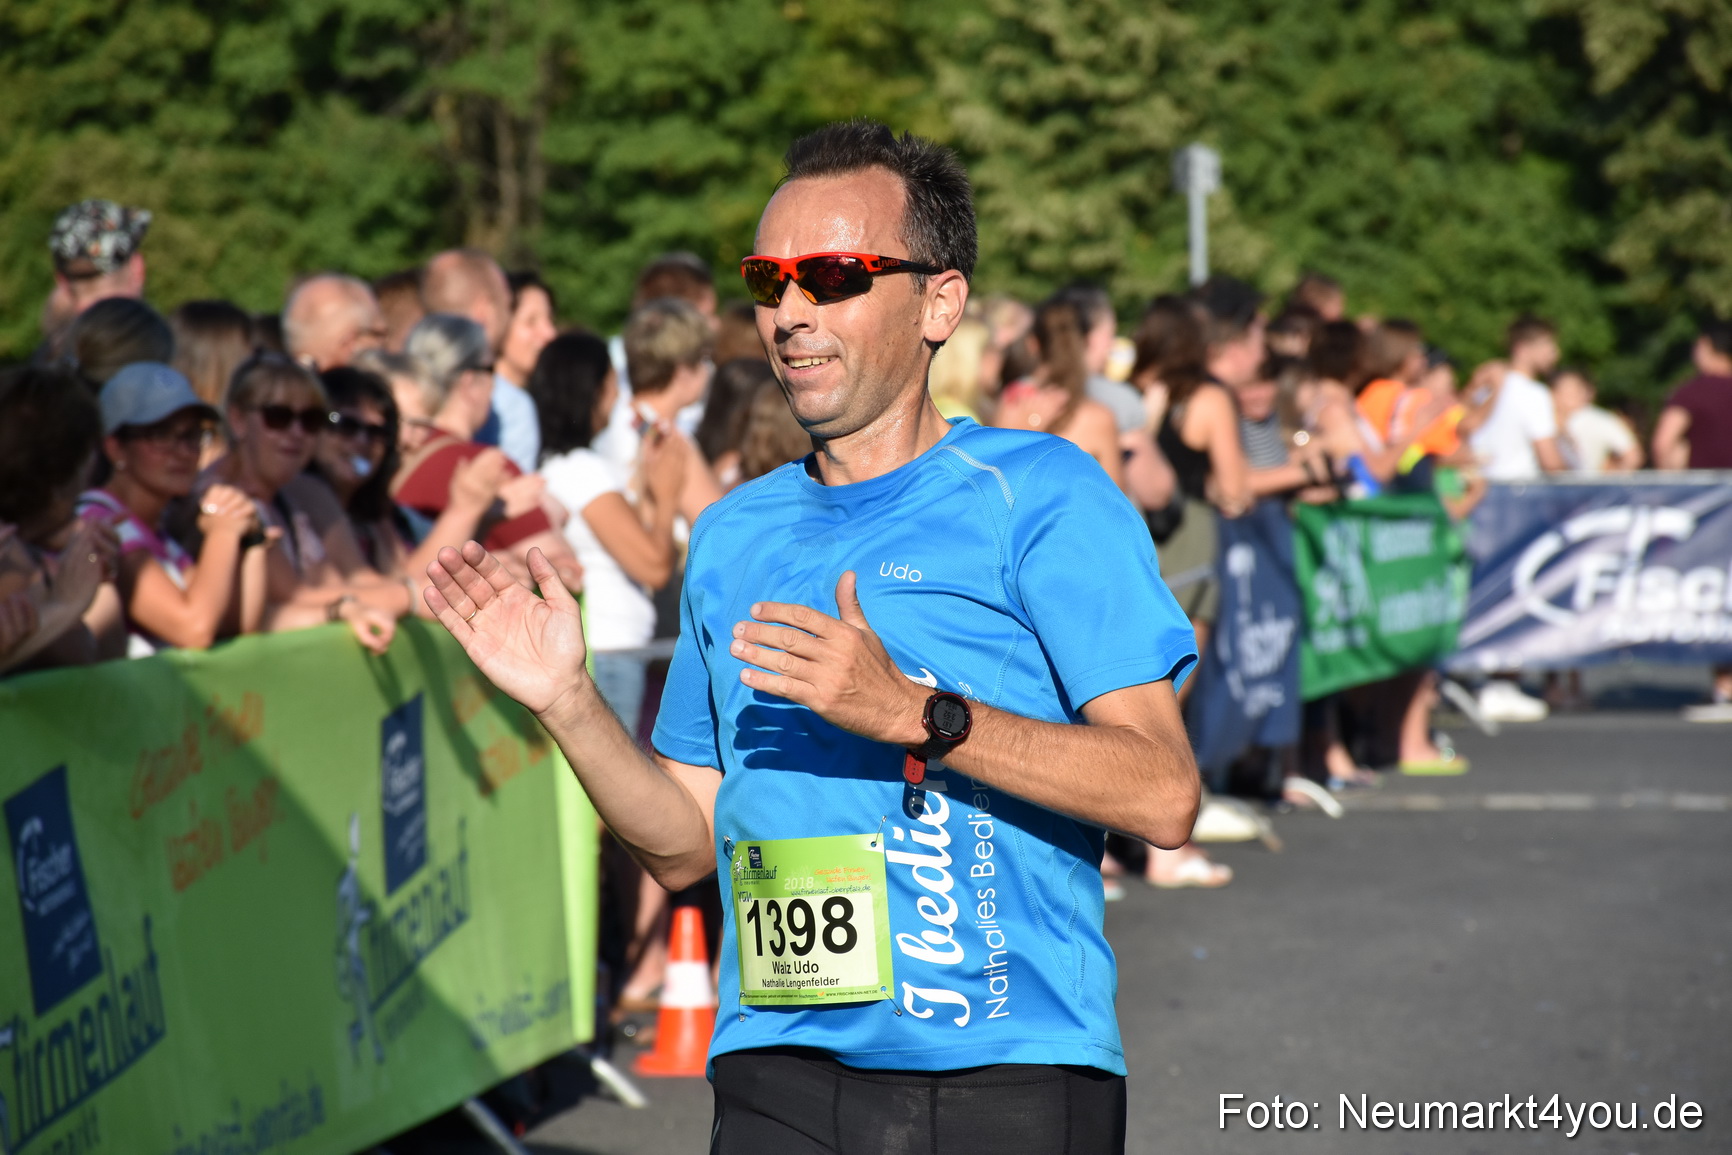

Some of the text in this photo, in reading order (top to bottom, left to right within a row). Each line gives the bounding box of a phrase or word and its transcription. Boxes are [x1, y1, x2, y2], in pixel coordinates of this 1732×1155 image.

[877, 258, 901, 269] uvex
[879, 561, 922, 583] Udo
[1572, 551, 1732, 613] Fisc
[743, 866, 778, 880] firmenlauf
[784, 876, 814, 890] 2018
[746, 895, 858, 958] 1398
[977, 888, 1010, 1019] Nathalies
[771, 960, 819, 975] Walz Udo
[762, 976, 840, 990] Nathalie Lengenfelder
[13, 914, 167, 1140] firmenlauf
